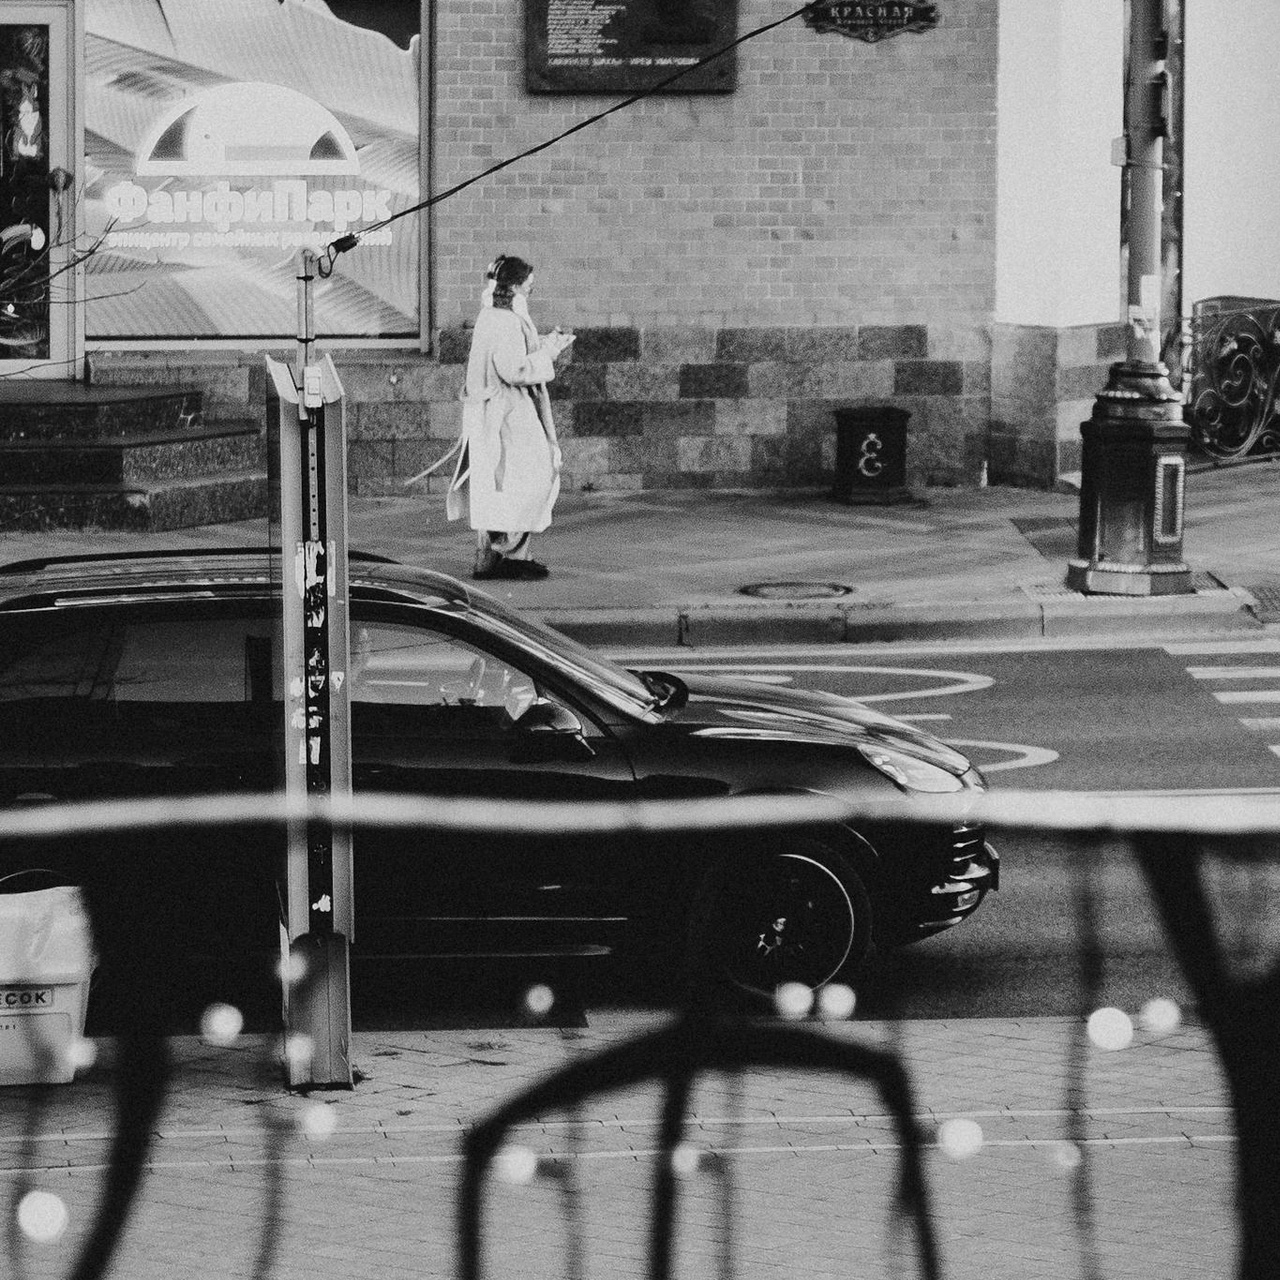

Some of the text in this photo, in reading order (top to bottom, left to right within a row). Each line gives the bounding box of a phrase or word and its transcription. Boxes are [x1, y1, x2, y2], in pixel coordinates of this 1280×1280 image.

[830, 6, 914, 19] КРАСНАЯ
[104, 180, 393, 232] ФанфиПарк
[0, 991, 47, 1006] СОК
